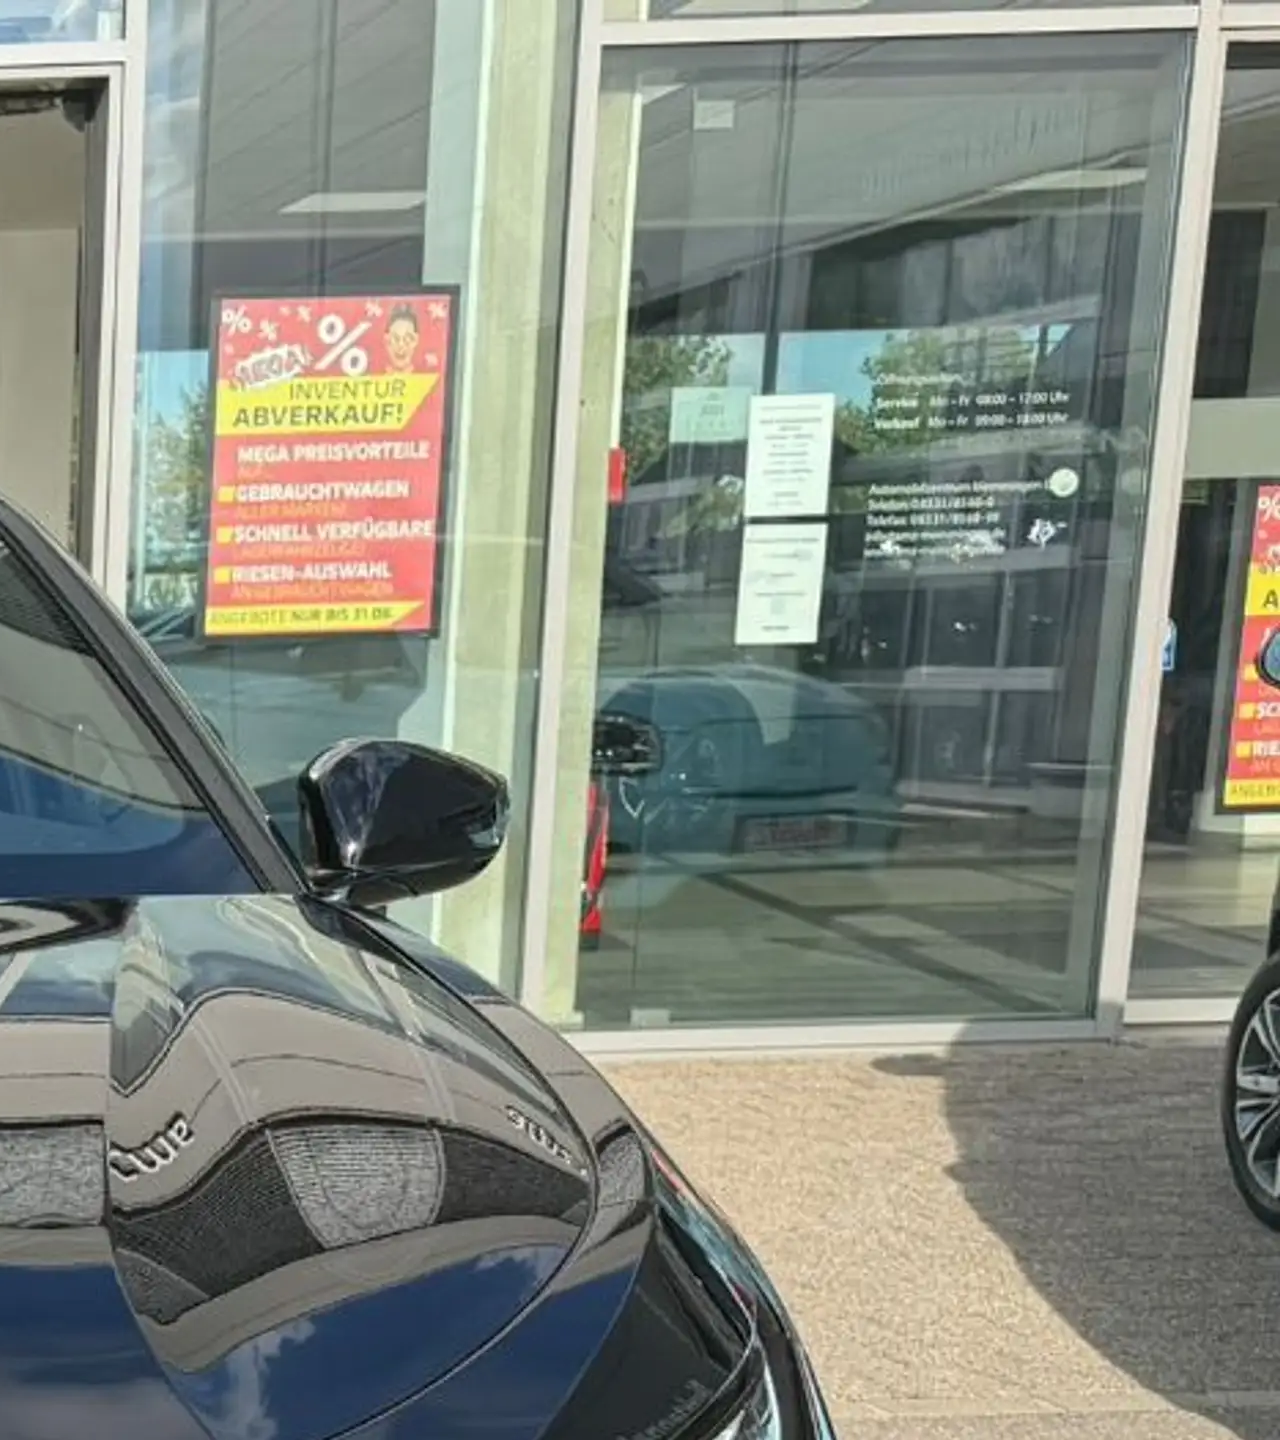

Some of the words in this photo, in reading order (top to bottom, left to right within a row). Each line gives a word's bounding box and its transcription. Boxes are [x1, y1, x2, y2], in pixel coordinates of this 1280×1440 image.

[289, 379, 407, 401] INVENTUR
[233, 402, 404, 428] ABVERKAUF!
[237, 444, 289, 463] MEGA
[293, 440, 431, 462] PREISVORTEILE
[236, 481, 410, 502] GEBRAUCHTWAGEN
[234, 525, 312, 544] SCHNELL
[316, 517, 434, 541] VERFÜGBARE
[232, 561, 393, 582] RIESEN-AUSWAHL
